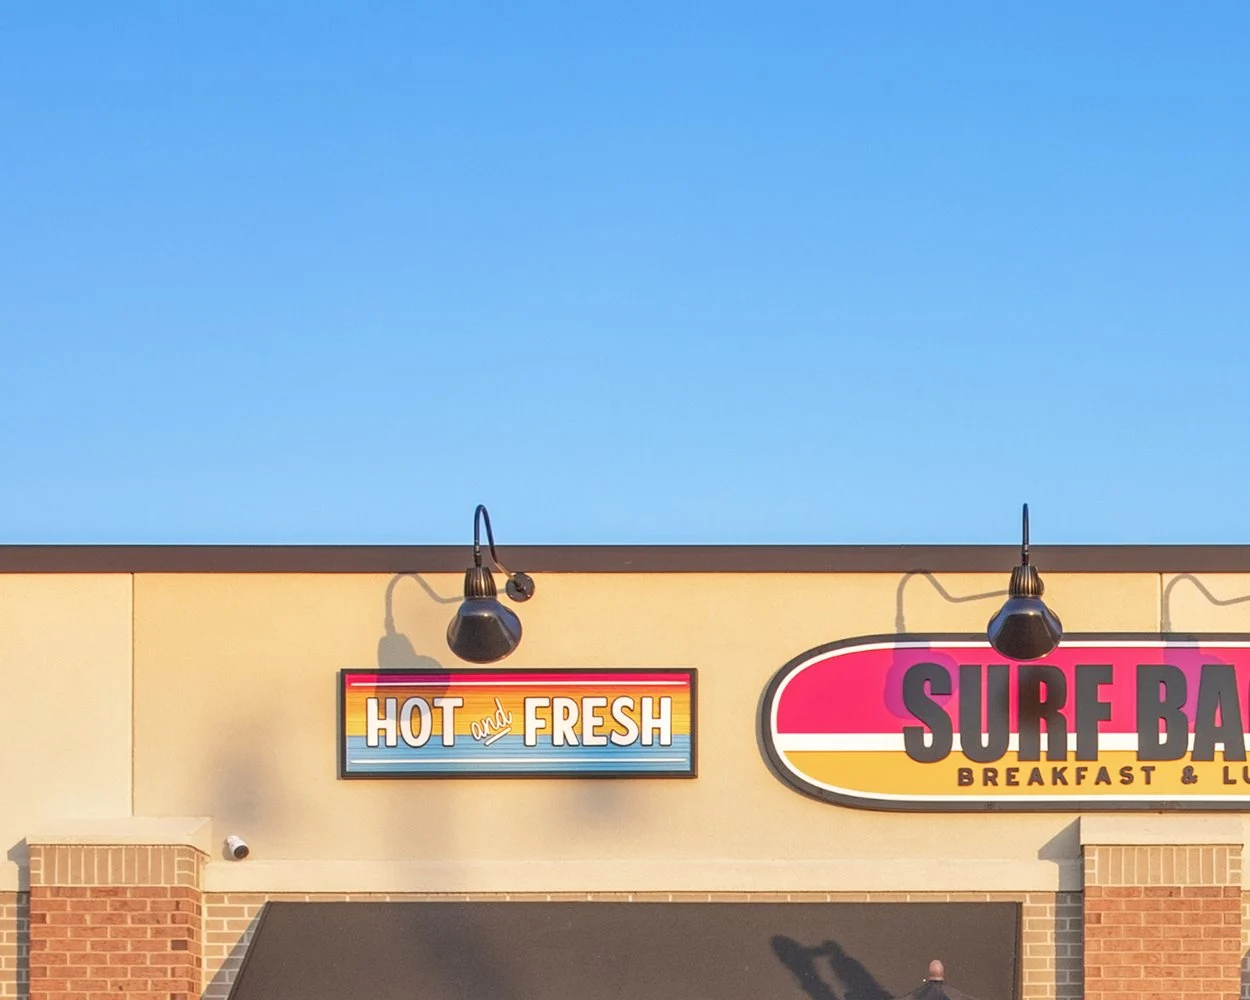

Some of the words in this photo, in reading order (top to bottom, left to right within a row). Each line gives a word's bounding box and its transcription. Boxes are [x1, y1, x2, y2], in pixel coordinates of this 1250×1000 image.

[366, 697, 464, 747] HOT
[470, 698, 512, 742] and
[523, 696, 672, 747] FRESH
[902, 662, 1114, 764] SURF
[957, 765, 1154, 787] BREAKFAST
[1180, 765, 1200, 785] &
